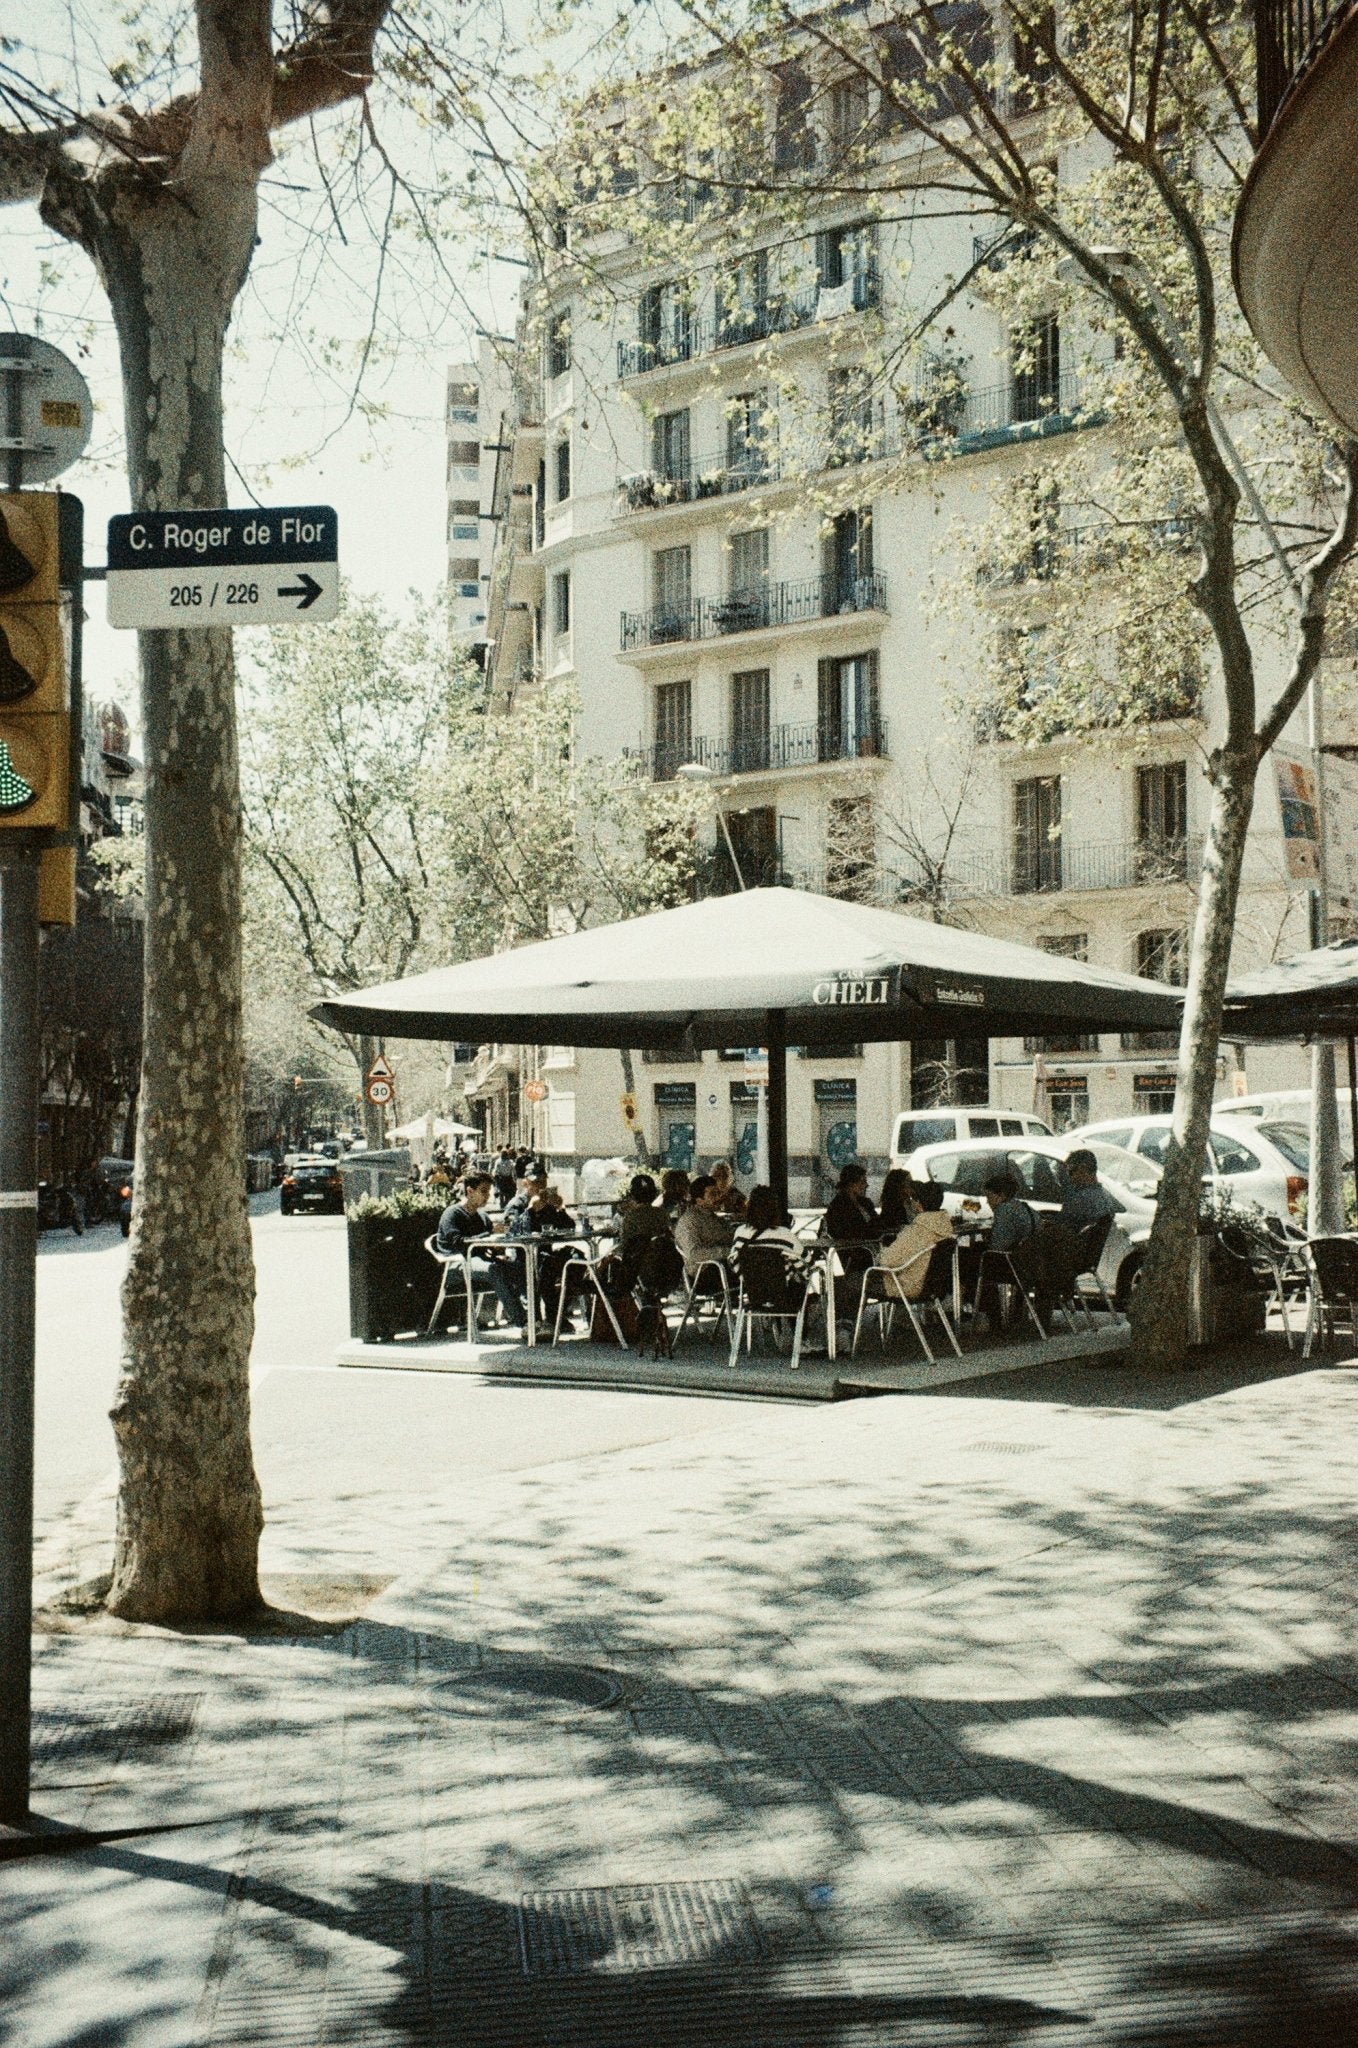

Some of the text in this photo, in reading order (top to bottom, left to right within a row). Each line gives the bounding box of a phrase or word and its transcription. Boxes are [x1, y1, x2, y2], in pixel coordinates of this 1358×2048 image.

[129, 518, 326, 553] C. Roger de Flor
[170, 582, 259, 607] 205 / 226
[812, 981, 889, 1005] CHELI
[372, 1087, 388, 1096] 30
